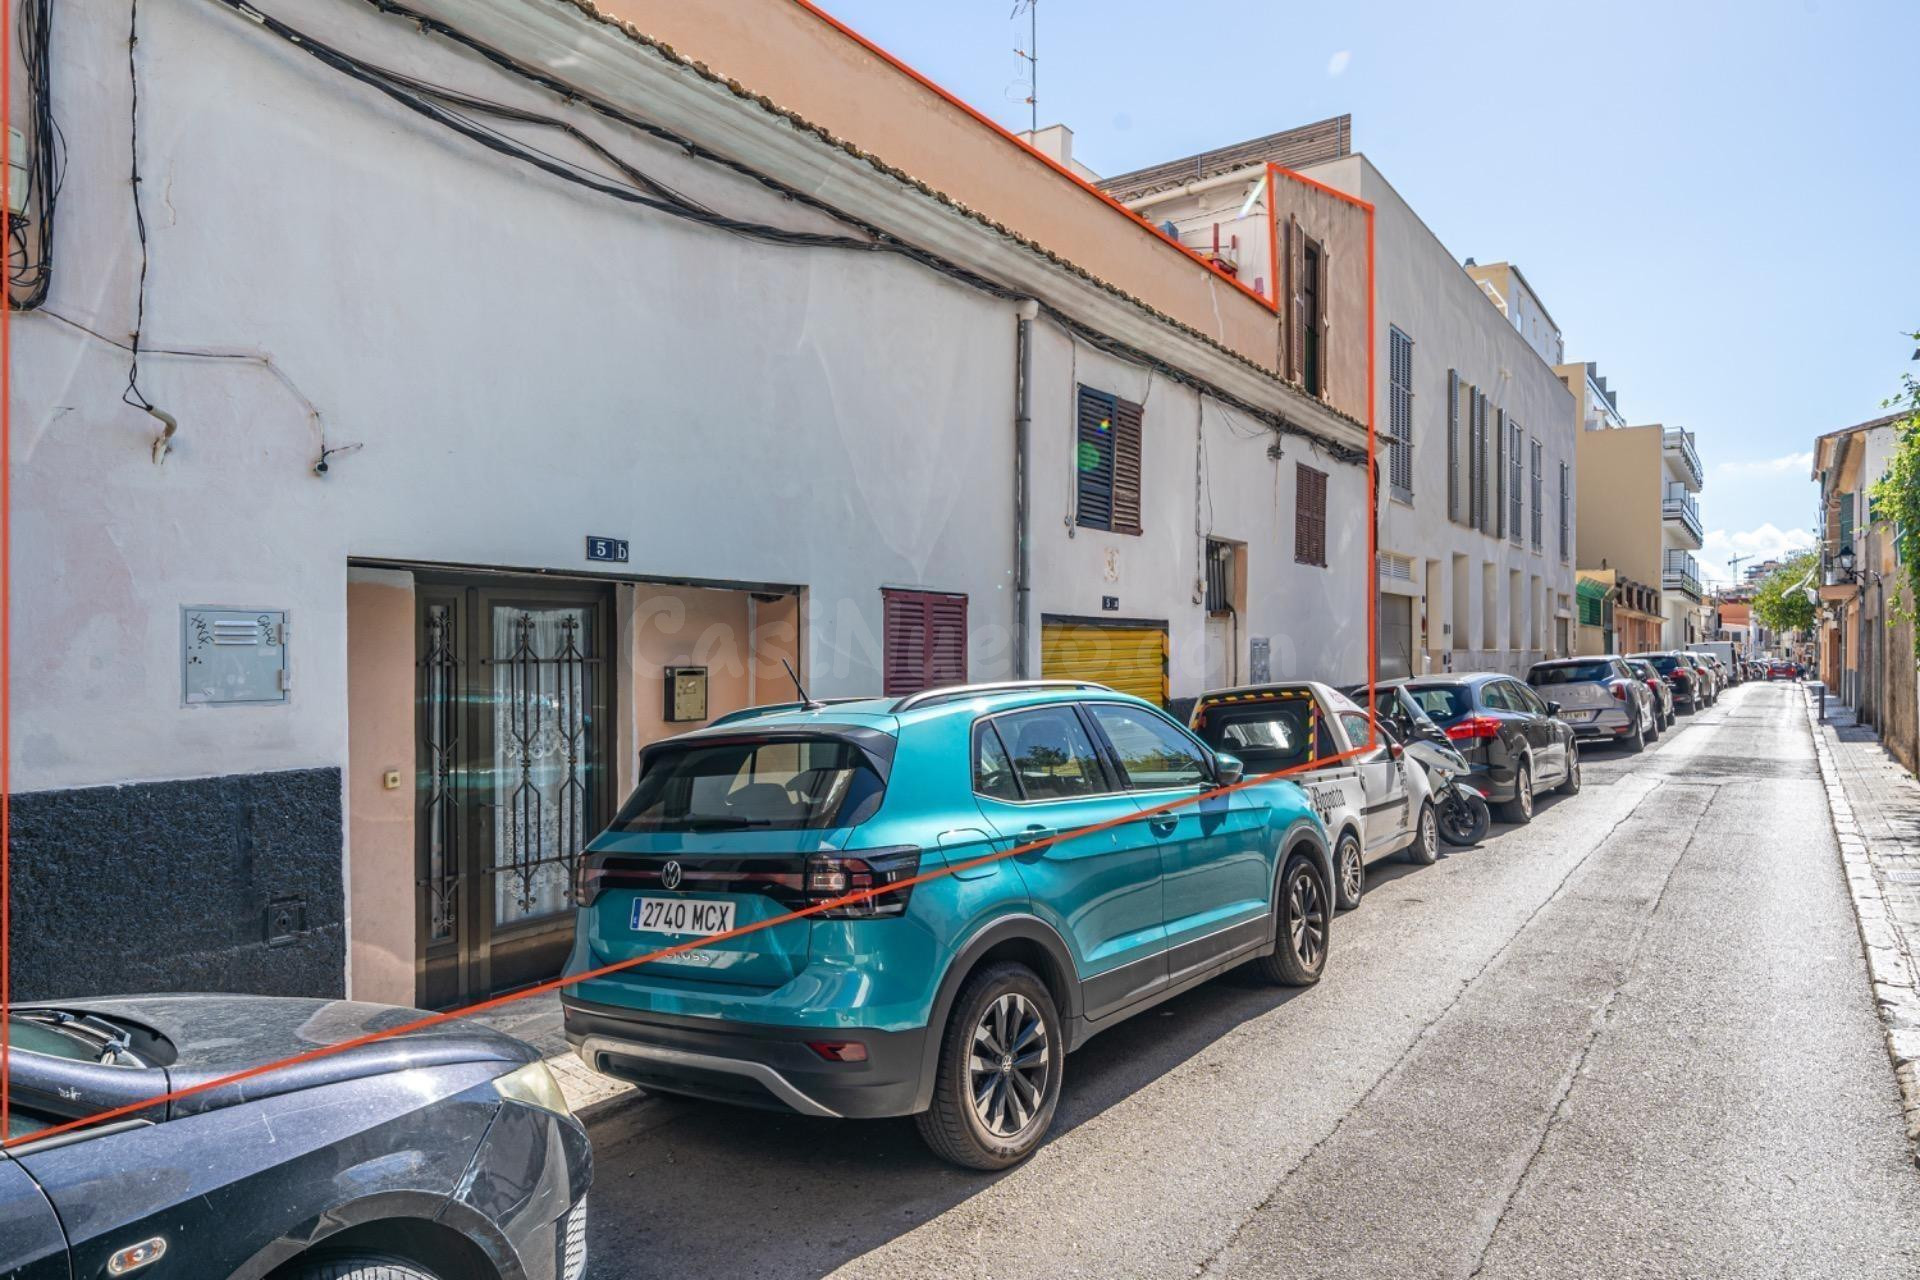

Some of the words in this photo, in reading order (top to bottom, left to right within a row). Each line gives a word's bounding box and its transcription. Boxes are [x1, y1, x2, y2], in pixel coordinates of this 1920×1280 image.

[597, 541, 606, 556] 5
[618, 543, 626, 559] b
[643, 902, 686, 928] 2740
[692, 904, 730, 931] MCX
